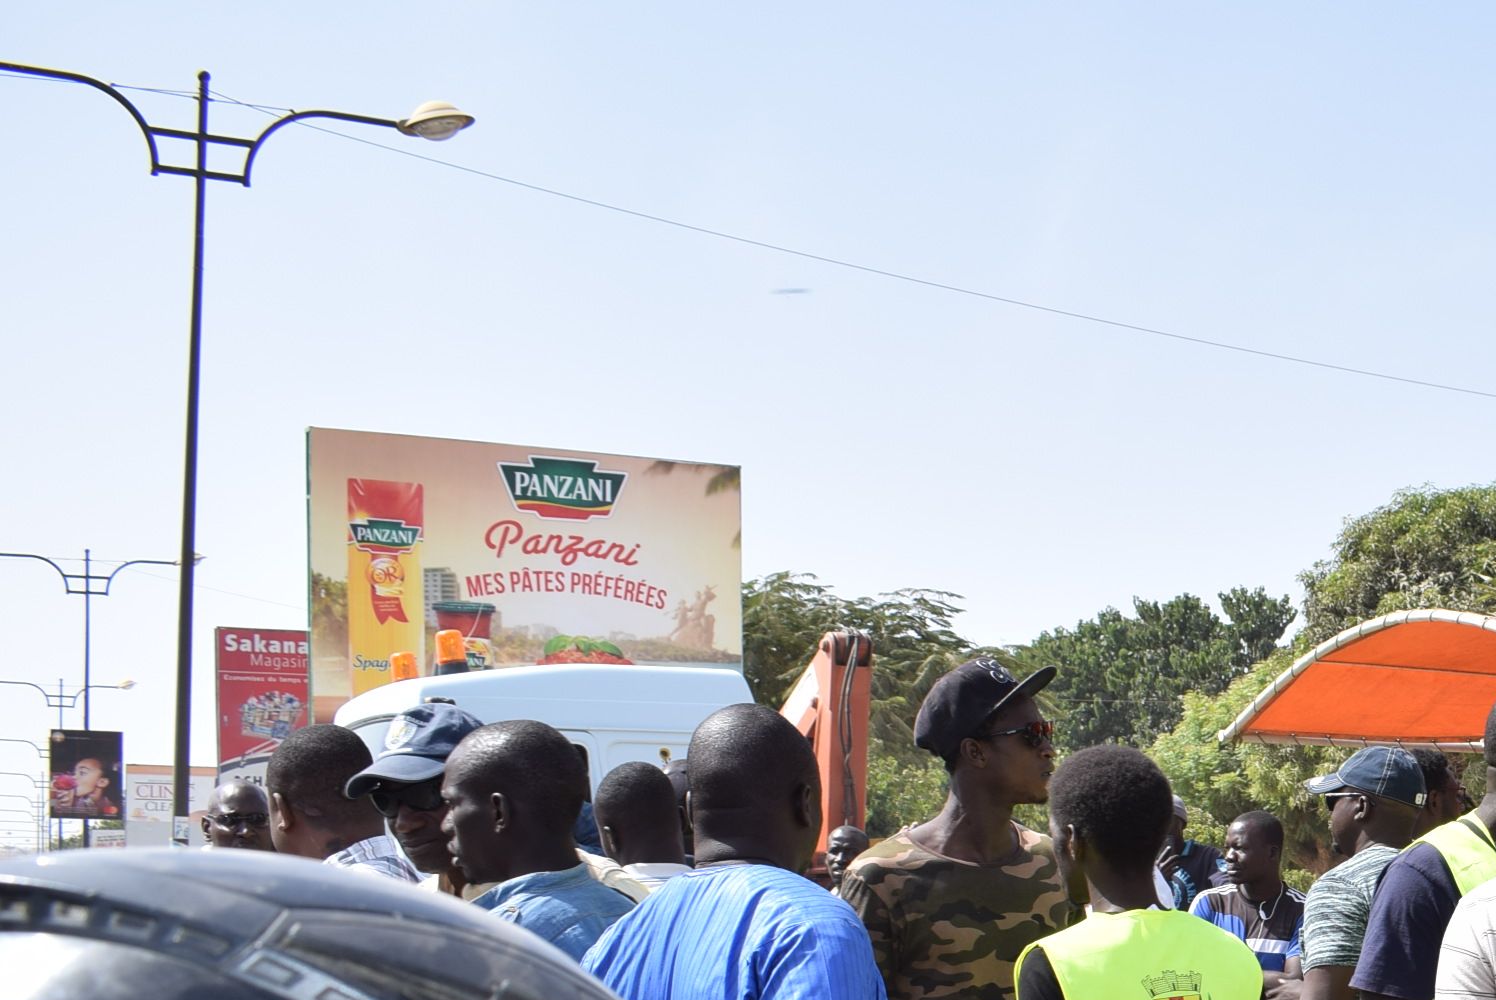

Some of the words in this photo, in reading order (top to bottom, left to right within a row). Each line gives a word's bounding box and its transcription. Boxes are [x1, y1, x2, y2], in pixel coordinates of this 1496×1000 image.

[514, 471, 613, 503] PANZANI
[356, 526, 414, 546] PANZANI
[484, 519, 642, 568] Panzani
[465, 573, 505, 599] MES
[510, 567, 565, 594] PÂTES
[570, 570, 668, 610] PRÉFÉRÉES
[224, 633, 309, 654] Sakana
[354, 654, 391, 671] Spag
